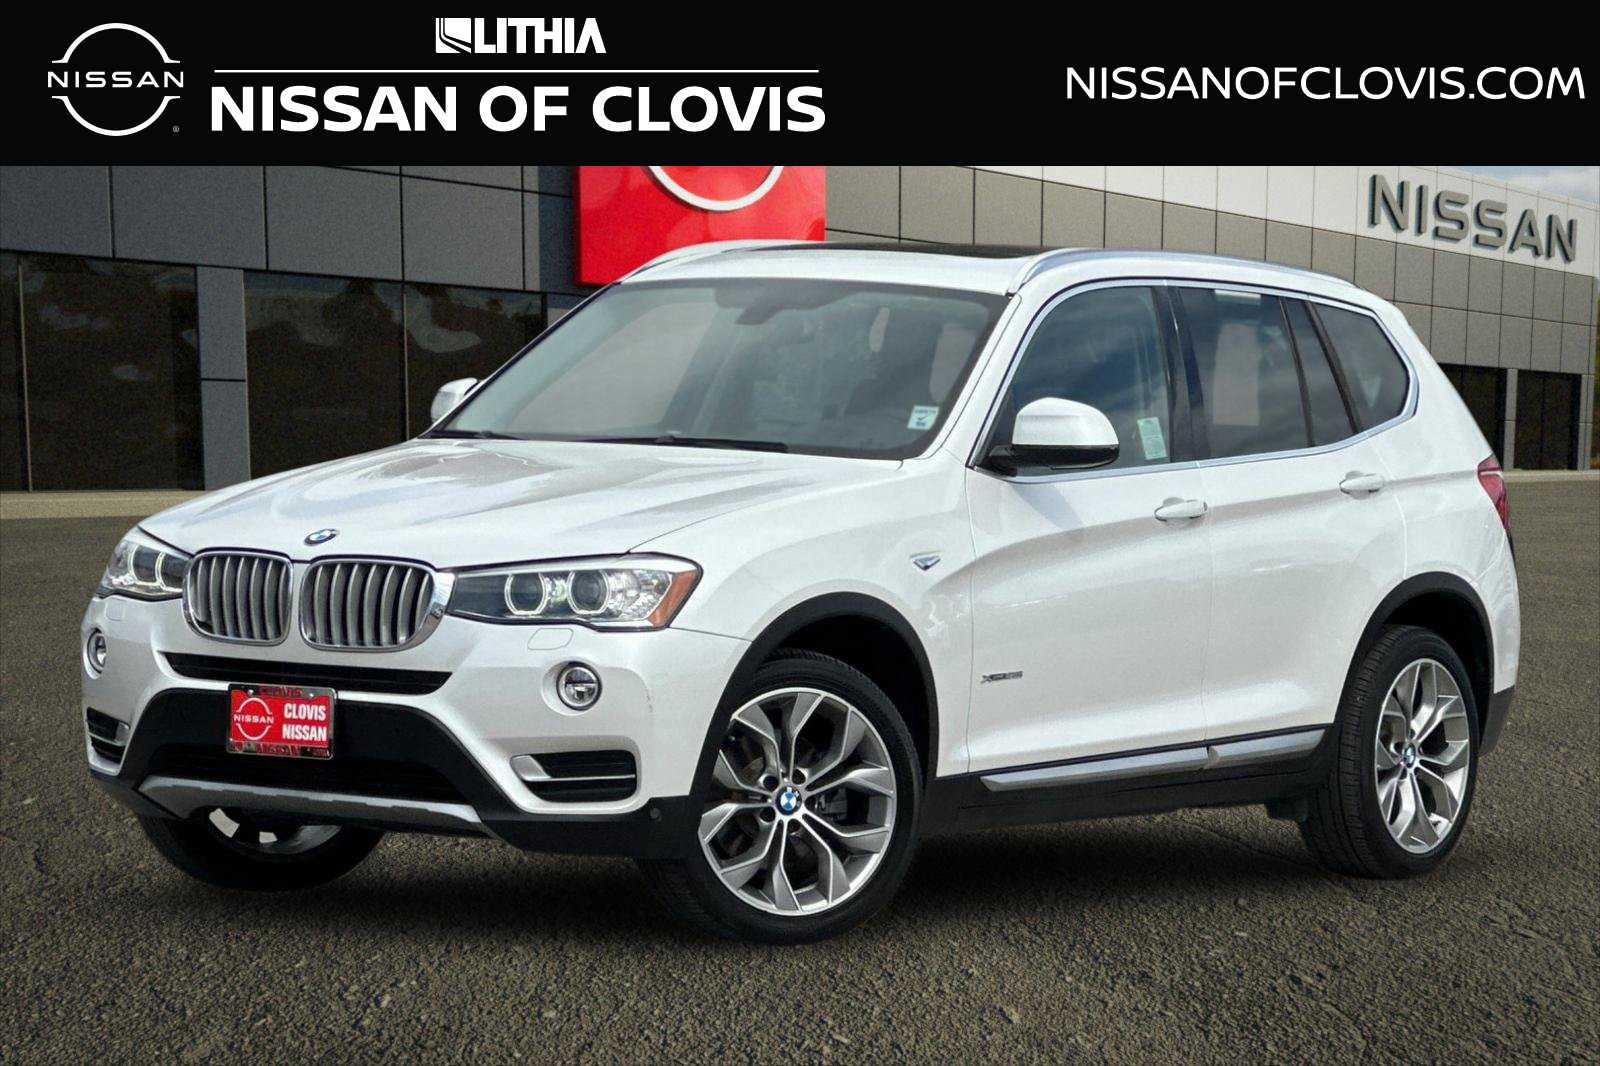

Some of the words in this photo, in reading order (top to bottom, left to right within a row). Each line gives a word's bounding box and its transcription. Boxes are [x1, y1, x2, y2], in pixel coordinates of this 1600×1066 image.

[1367, 173, 1578, 264] NISSAN
[233, 714, 274, 724] NISSAN
[283, 703, 326, 721] CLOVIS
[282, 724, 327, 742] NISSAN
